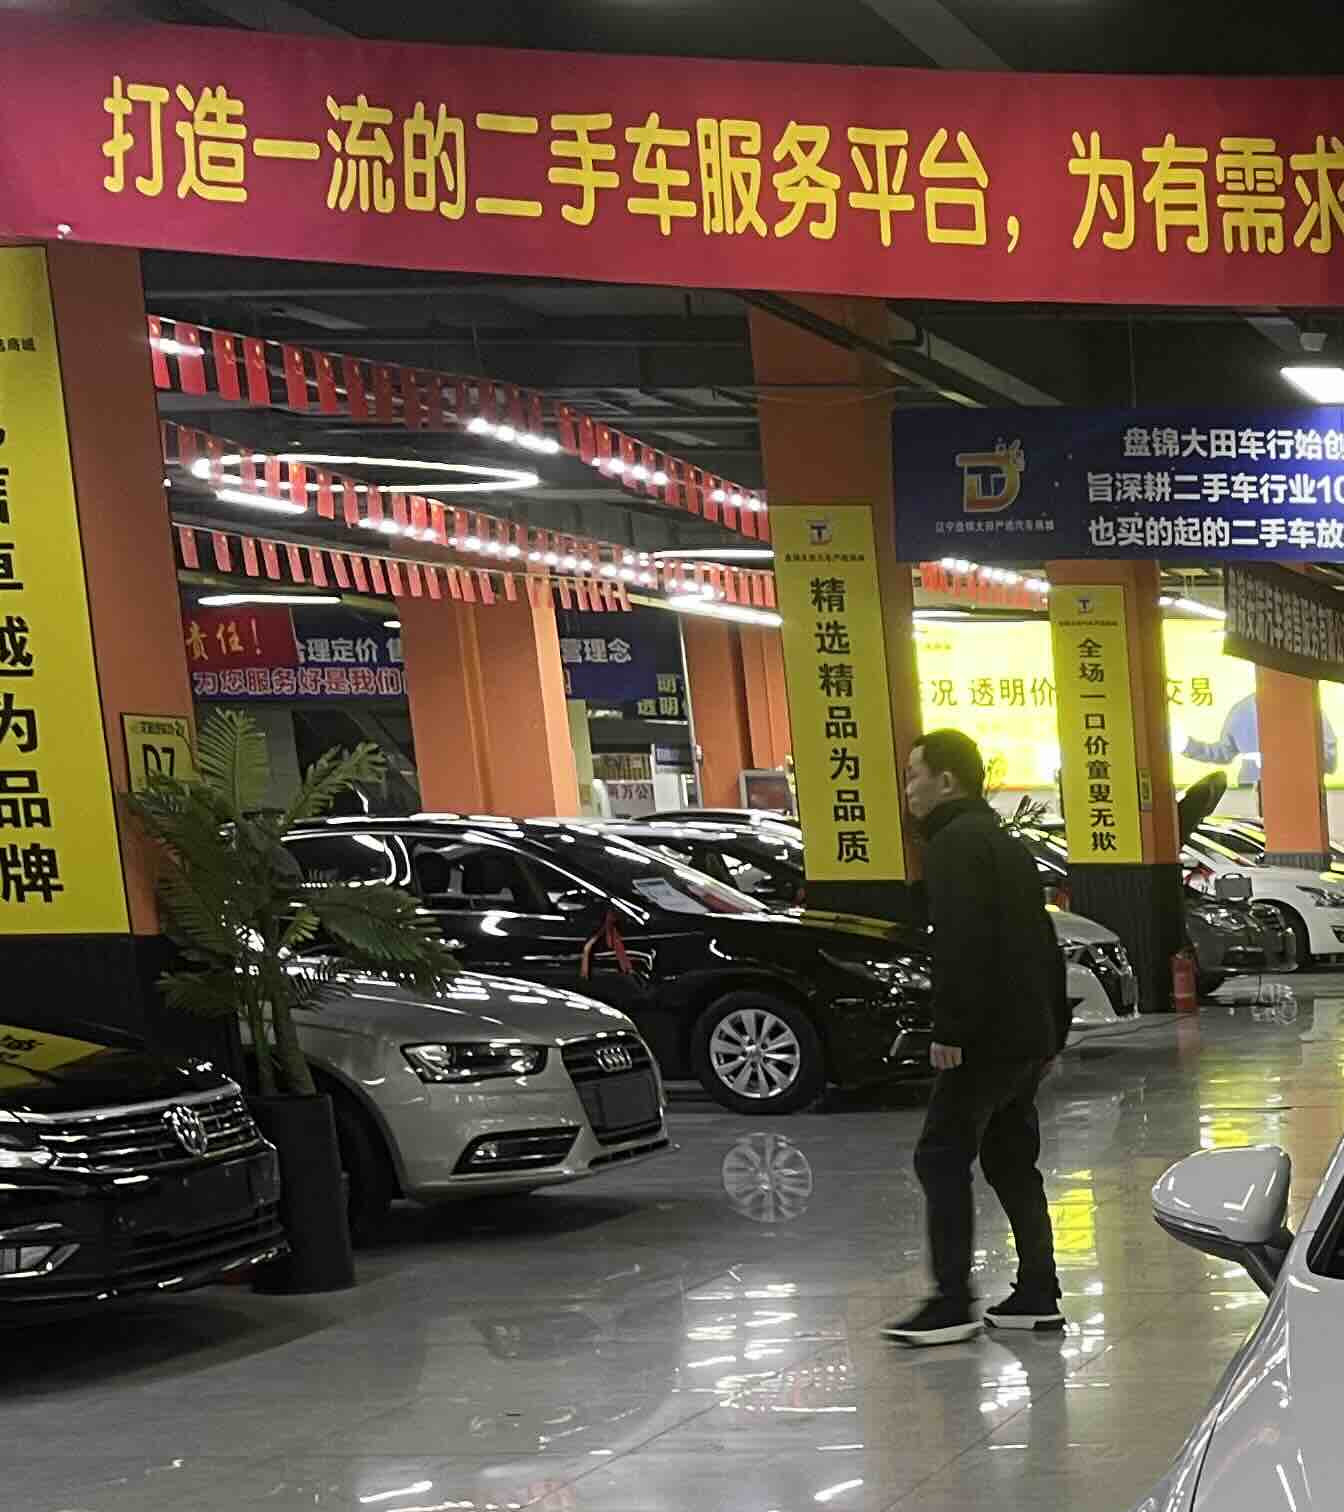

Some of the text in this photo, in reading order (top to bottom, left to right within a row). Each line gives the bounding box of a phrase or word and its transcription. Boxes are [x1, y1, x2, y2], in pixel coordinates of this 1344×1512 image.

[193, 667, 409, 695] 为您服务好是我们
[809, 577, 871, 864] 精选精品为品质
[1077, 637, 1119, 852] 全场一口价童叟无欺
